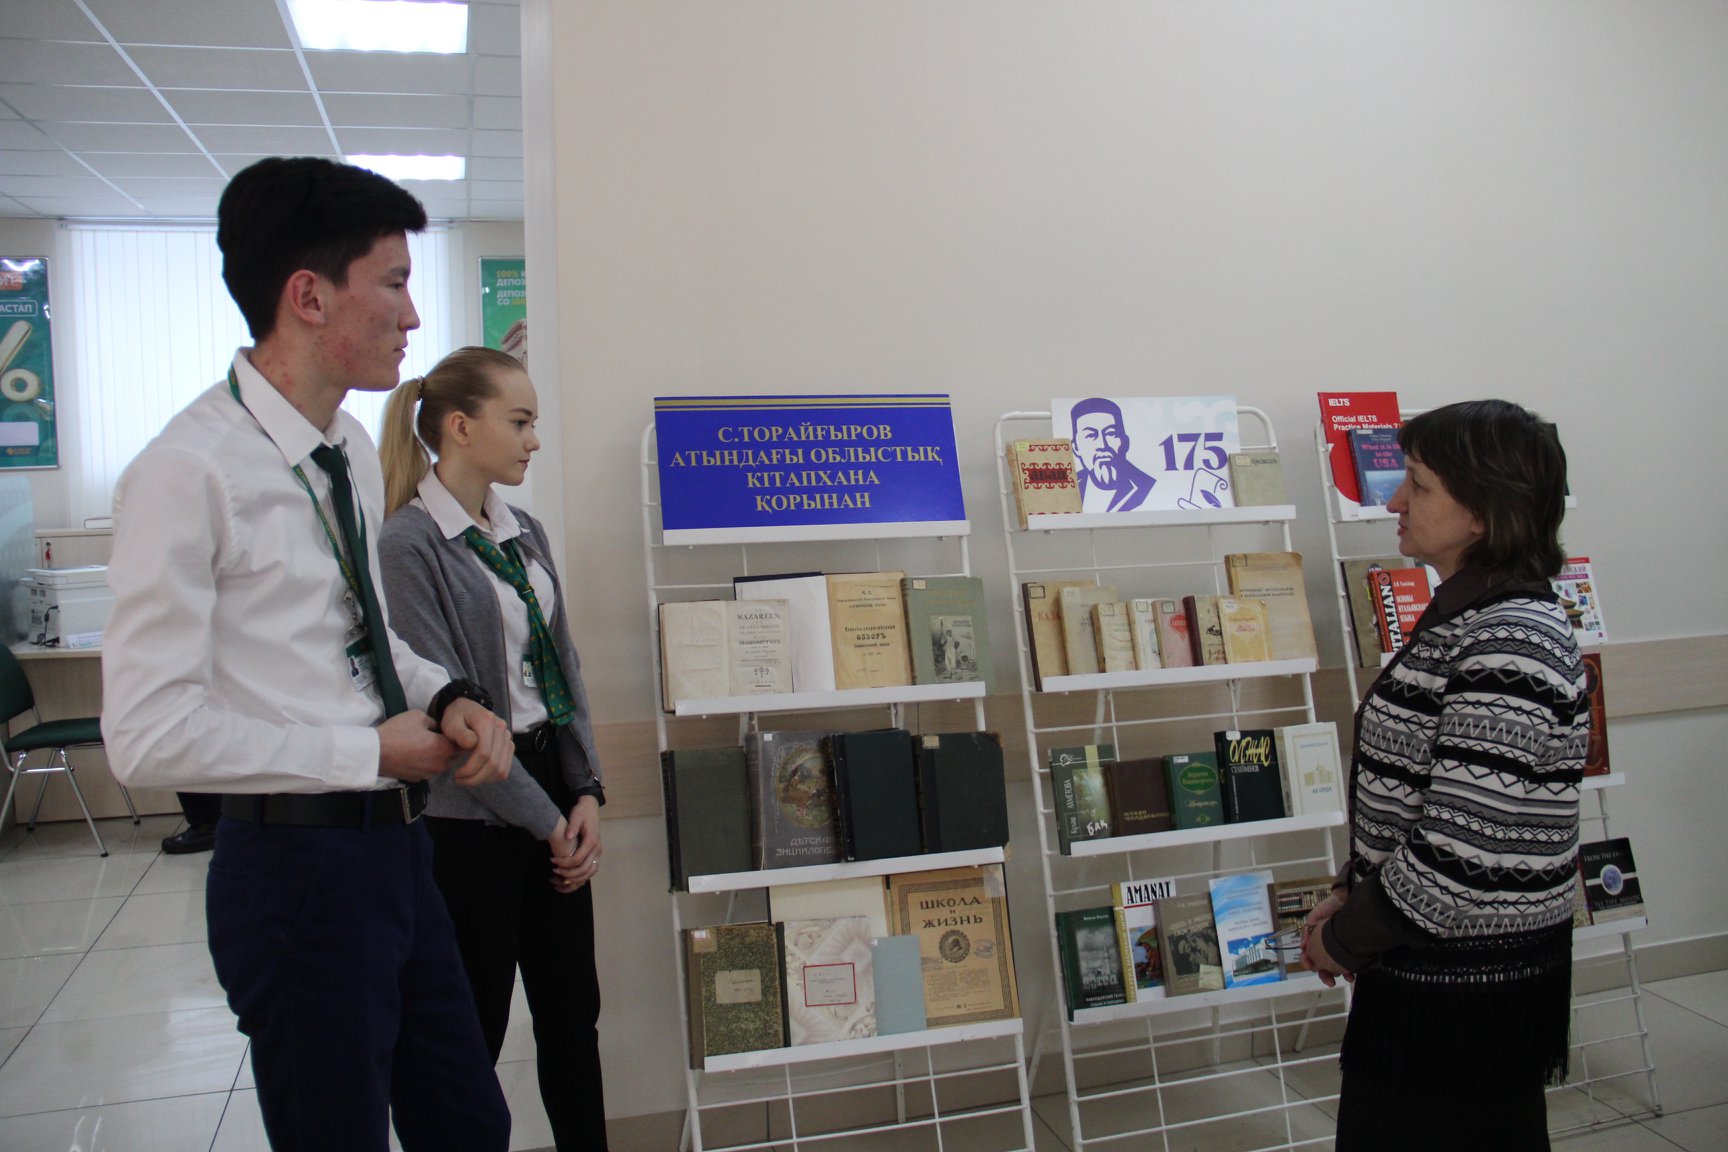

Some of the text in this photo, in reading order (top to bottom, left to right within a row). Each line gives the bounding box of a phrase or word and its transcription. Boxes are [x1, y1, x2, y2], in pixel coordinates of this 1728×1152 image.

[1328, 398, 1350, 407] IELTS
[1332, 415, 1377, 423] Official IELTS
[718, 422, 893, 444] С.ТОРАЙҒЫРОВ
[670, 446, 943, 470] АТЫНДАҒЫ ОБЛЫСТЫҚ
[1158, 432, 1228, 471] 175
[1372, 458, 1399, 468] USA
[746, 469, 880, 488] КІТАПХАНА
[755, 492, 872, 514] ҚОРЫНАН
[1380, 585, 1404, 648] ITALIAN
[920, 896, 983, 911] ШКОЛА
[922, 914, 984, 929] ЖИЗНЬ
